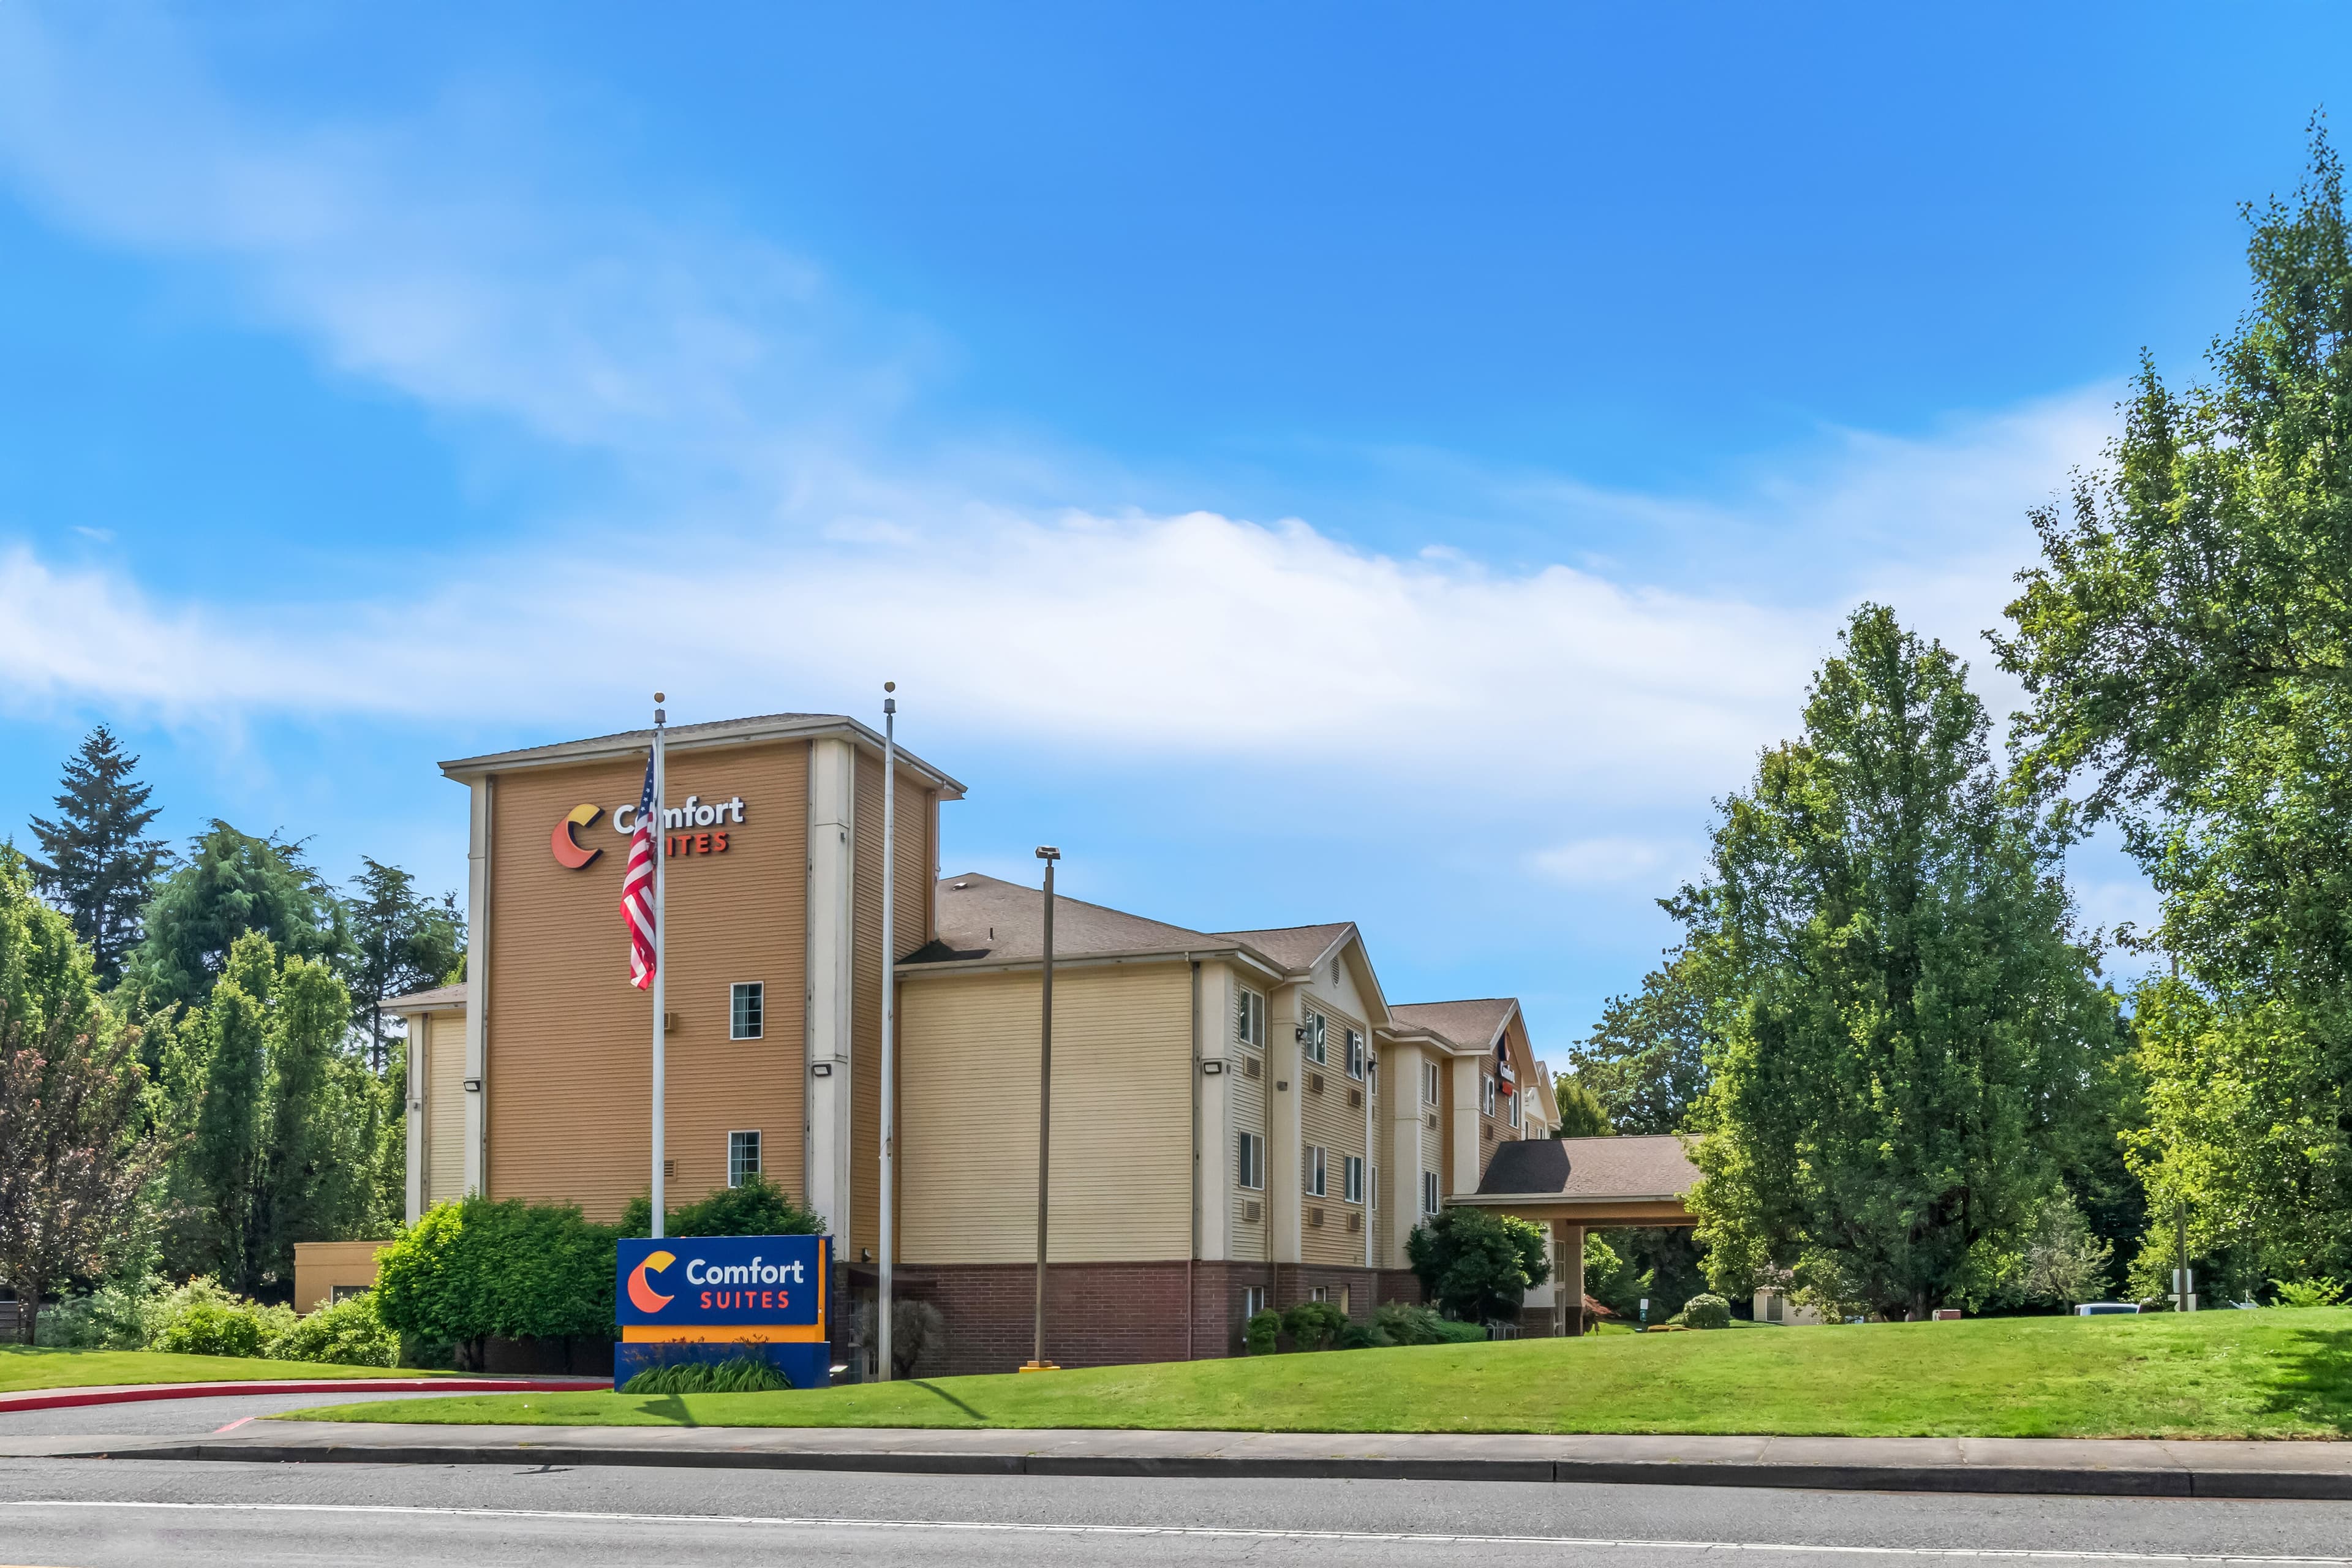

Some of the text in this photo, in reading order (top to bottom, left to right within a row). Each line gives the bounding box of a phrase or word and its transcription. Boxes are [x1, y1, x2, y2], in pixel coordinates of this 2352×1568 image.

[613, 796, 744, 834] Cmfort
[666, 832, 726, 856] ITES
[686, 1256, 804, 1285] Comfort
[700, 1290, 790, 1309] SUITES
